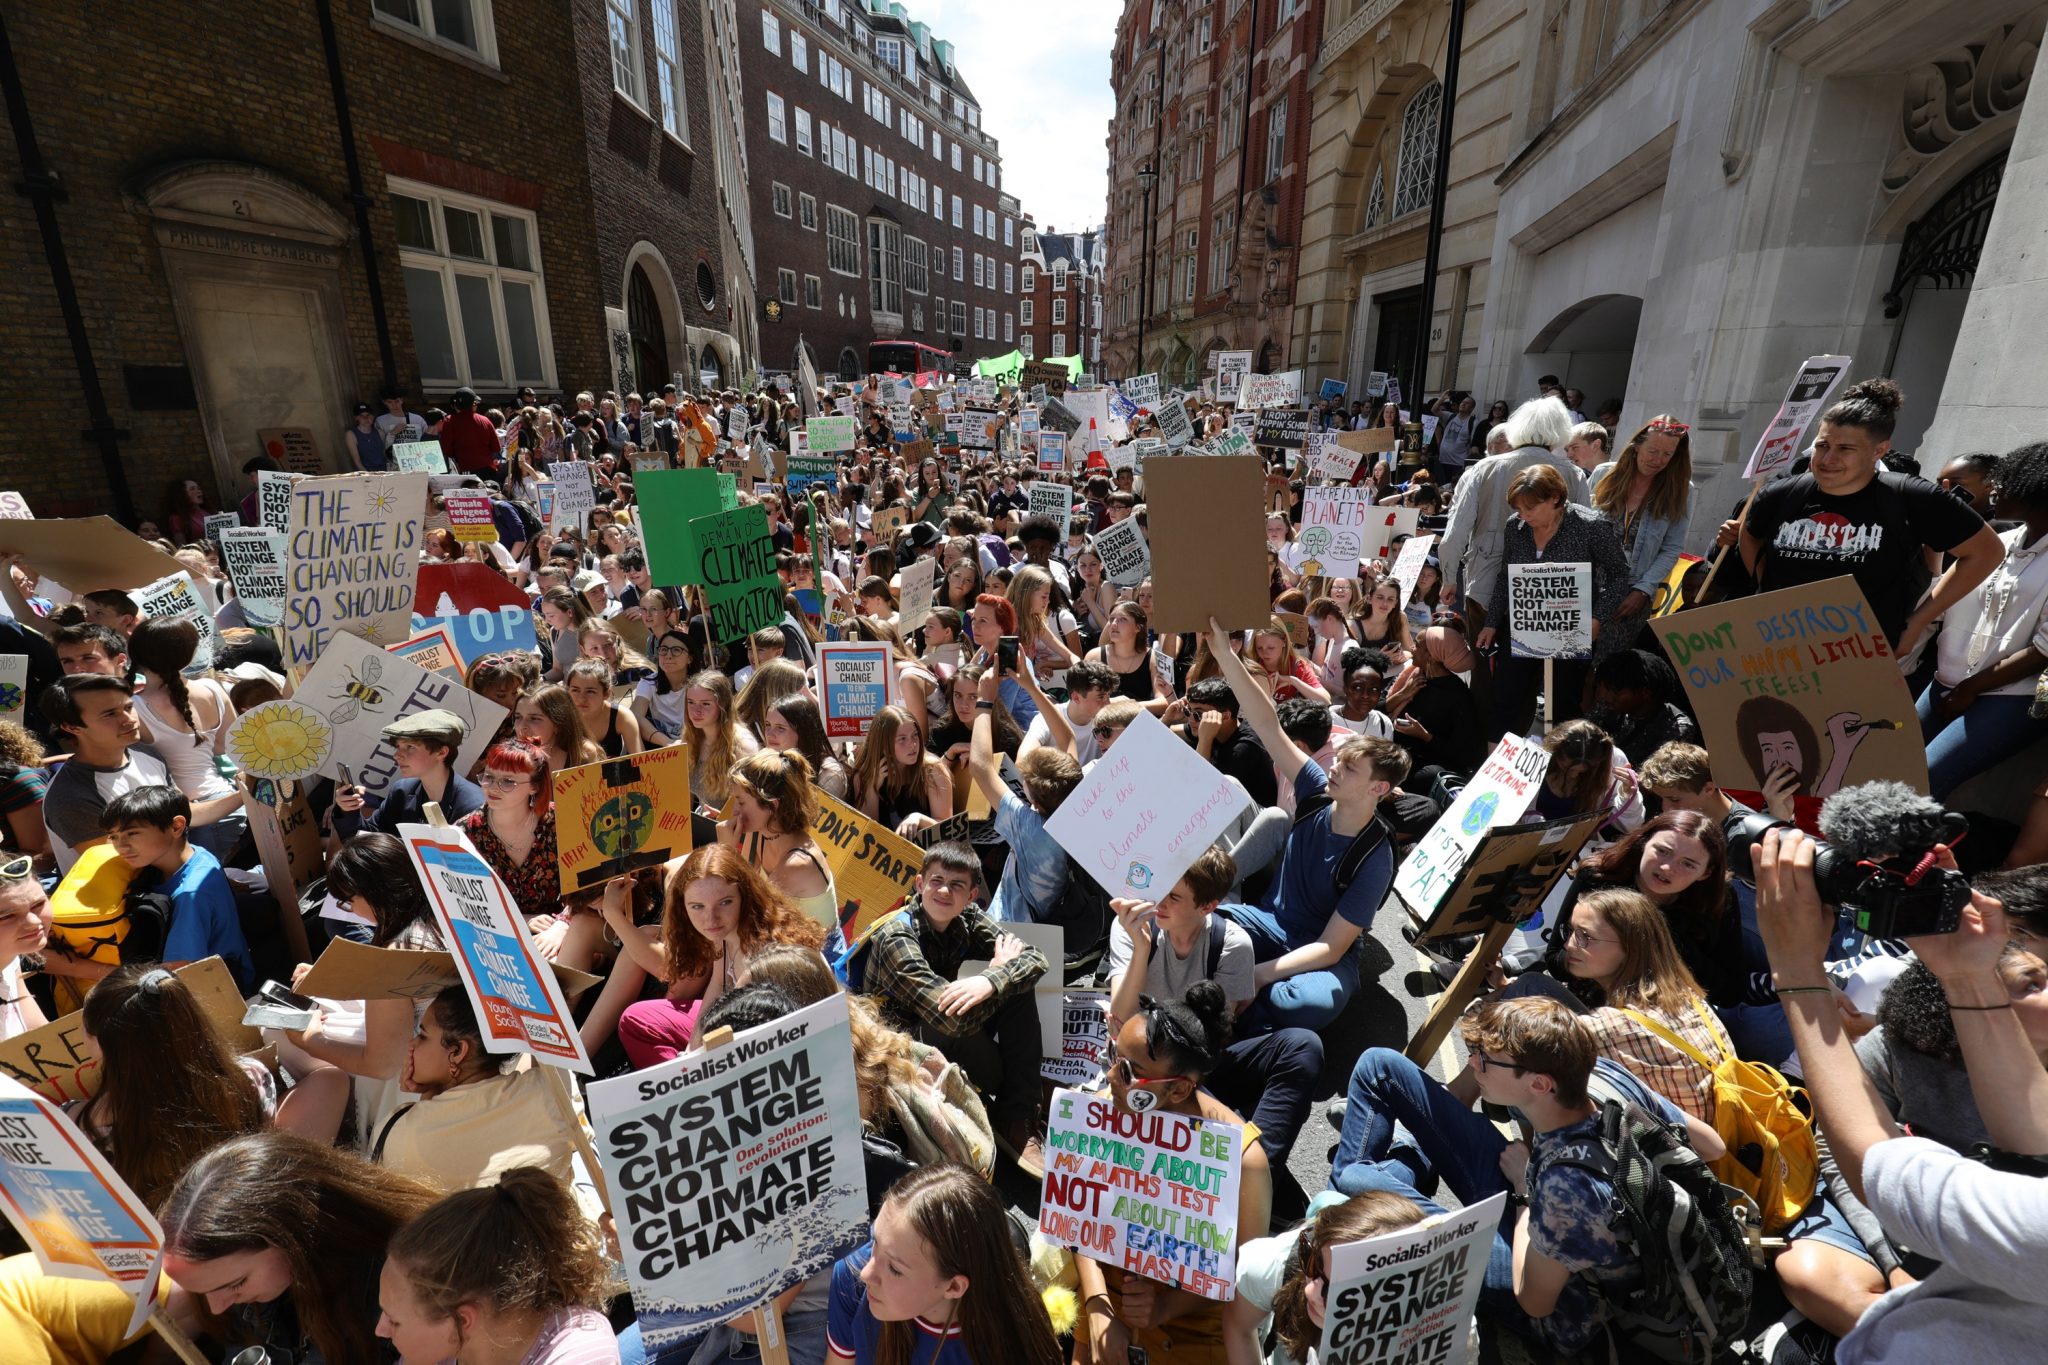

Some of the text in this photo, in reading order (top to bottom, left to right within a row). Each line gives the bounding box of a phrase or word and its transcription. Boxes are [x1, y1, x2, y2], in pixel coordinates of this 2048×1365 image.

[170, 230, 331, 265] PHILLIMORE CHAMBERS
[551, 462, 587, 473] SYSTEM
[1327, 452, 1356, 469] FRACK
[554, 470, 588, 482] CHANGE
[447, 499, 483, 508] Climate
[557, 489, 592, 501] CLIMATE
[560, 498, 593, 511] CHANGE
[1030, 489, 1065, 500] SYSTEM
[1030, 496, 1066, 508] CHANGE
[1305, 486, 1369, 501] THERE IS NO
[295, 489, 353, 527] THE
[450, 507, 490, 518] refugees
[451, 515, 491, 524] welcome
[1030, 504, 1047, 513] NOT
[1302, 500, 1366, 527] PLANET B
[206, 519, 233, 529] SYSTEM
[701, 522, 752, 547] DEMAND
[224, 540, 271, 553] SYSTEM
[292, 521, 387, 560] CLIMATE
[395, 519, 417, 550] IS
[1097, 527, 1133, 550] SYSTEM
[1100, 533, 1137, 557] CHANGE
[228, 552, 278, 565] CHANGE
[232, 564, 255, 576] NOT
[701, 535, 778, 587] CLIMATE
[1103, 549, 1122, 564] NOT
[1106, 547, 1144, 575] CLIMATE
[1109, 555, 1145, 578] CHANGE
[1521, 566, 1576, 574] Socialist Worker
[236, 575, 286, 588] CLIMATE
[294, 552, 412, 593] CHANGING,
[1512, 576, 1576, 588] SYSTEM
[239, 587, 286, 599] CHANGE
[1512, 587, 1579, 599] CHANGE
[1513, 599, 1544, 610] NOT
[287, 584, 412, 631] SO SHOULD
[709, 586, 785, 644] EDUCATION
[1513, 609, 1581, 622] CLIMATE
[1513, 620, 1579, 632] CHANGE
[1756, 601, 1869, 643] DESTROY
[289, 627, 330, 664] WE
[835, 661, 876, 672] SOCIALIST
[1687, 632, 1888, 689] OUR HAPPY LITTLE
[839, 672, 872, 683] CHANGE
[1740, 670, 1823, 697] TREES!
[837, 692, 877, 704] CLIMATE
[839, 704, 877, 716] CHANGE
[1498, 738, 1548, 785] THE CLOCK
[555, 767, 586, 796] HELP
[1482, 761, 1529, 797] IS TICKING
[1116, 782, 1137, 807] the
[658, 810, 689, 832] HELP!
[1167, 778, 1234, 854] emergency
[810, 805, 861, 850] IDN'T
[853, 832, 918, 887] START
[1099, 808, 1158, 872] Climate
[560, 841, 590, 870] HELP!
[1411, 848, 1429, 869] TO
[456, 897, 497, 930] CHANGE
[637, 1020, 810, 1102] Socialist Worker
[1040, 1064, 1088, 1077] LECTION
[608, 1048, 812, 1160] SYSTEM
[618, 1075, 825, 1191] CHANGE
[735, 1109, 829, 1164] One solution:
[1058, 1098, 1232, 1162] I SHOULD BE
[738, 1131, 810, 1176] revolution
[1049, 1126, 1228, 1197] WORRYING ABOUT
[625, 1154, 730, 1225] NOT
[632, 1135, 836, 1251] CLIMATE
[1053, 1151, 1221, 1217] MY MATHS TEST
[638, 1166, 834, 1281] CHANGE
[1044, 1171, 1234, 1255] NOT ABOUT HOW
[1039, 1207, 1221, 1279] LONG OUR EARTH
[1364, 1219, 1480, 1273] Socialist Worker
[1123, 1247, 1173, 1282] HAS
[726, 1265, 781, 1296] swp.org.uk
[1332, 1243, 1471, 1321] SYSTEM
[1329, 1269, 1469, 1350] CHANGE
[1326, 1330, 1399, 1365] NOT
[1420, 1301, 1463, 1326] solution:
[1399, 1319, 1446, 1351] revolution
